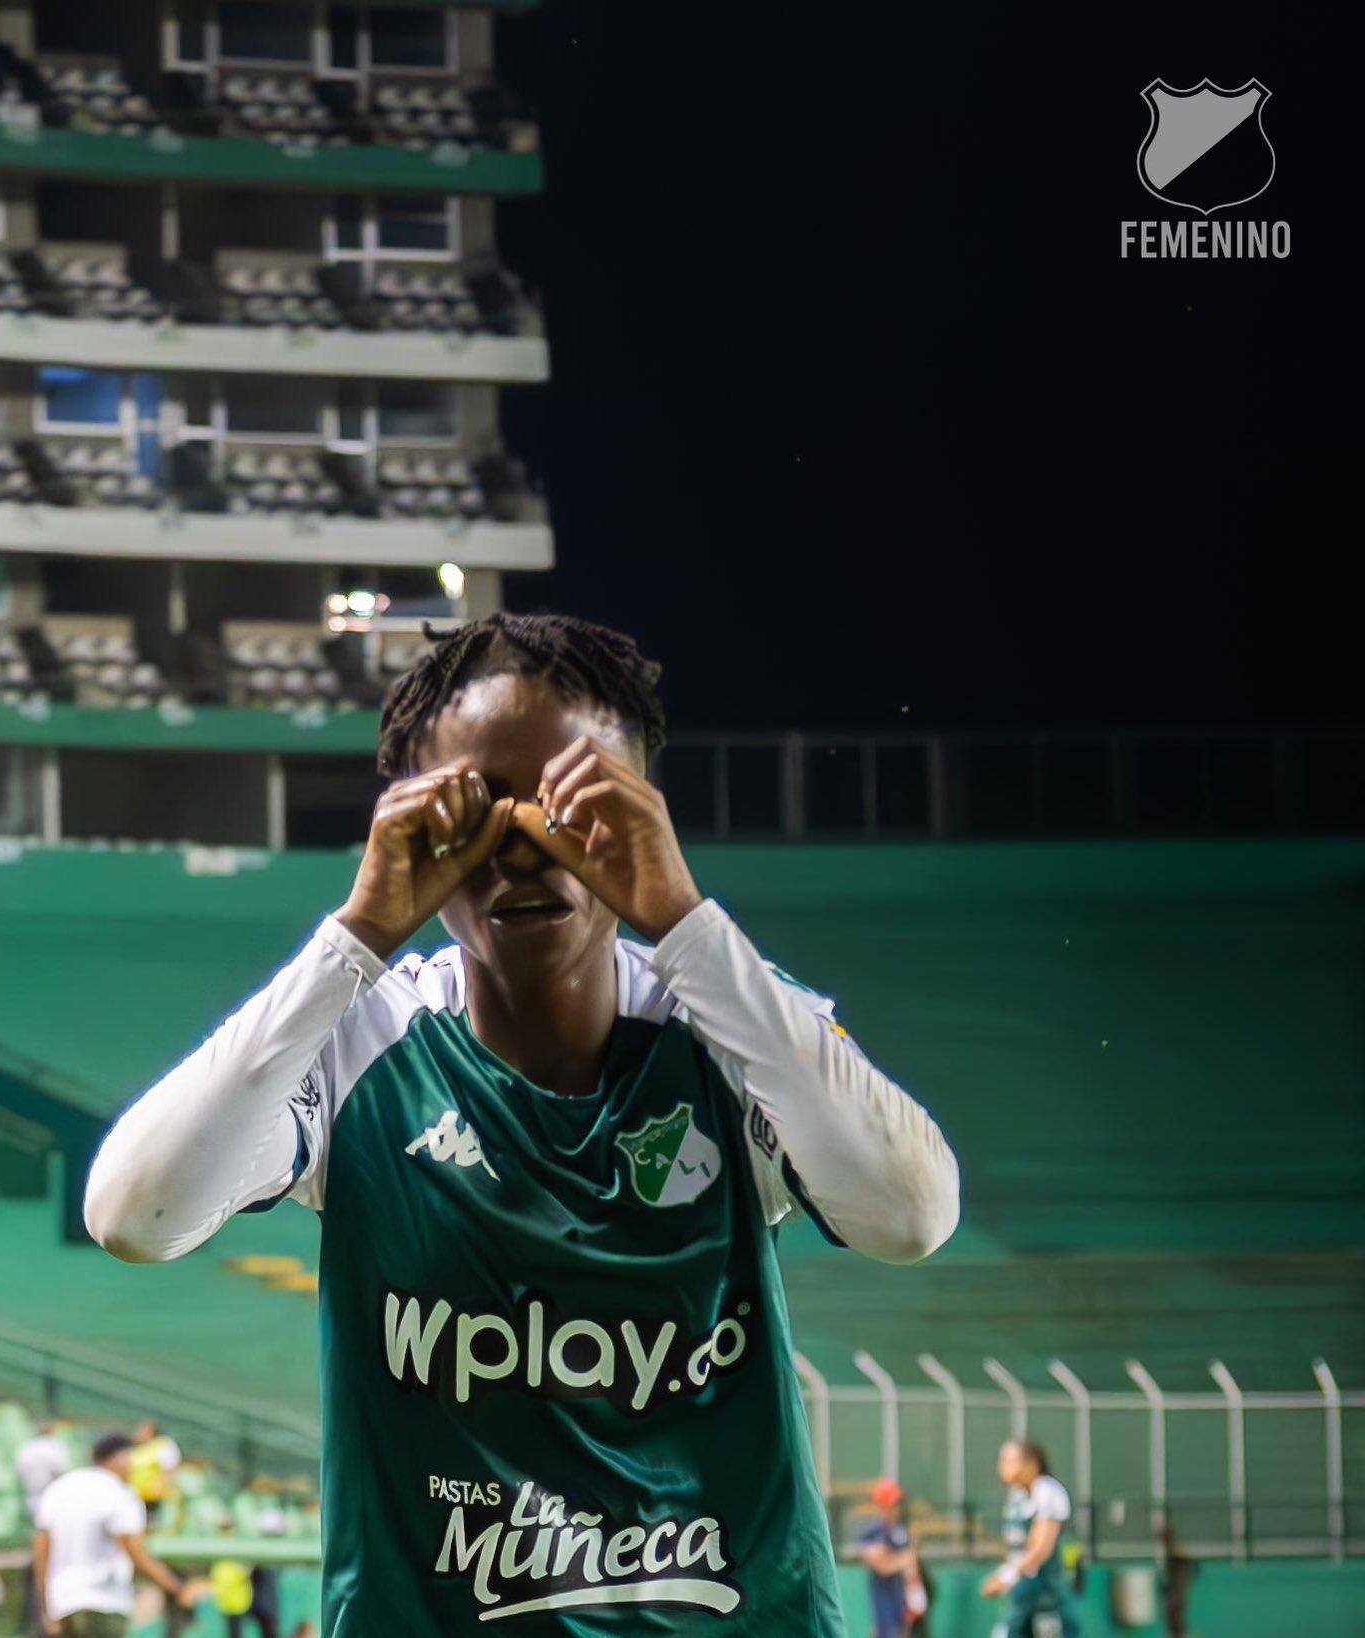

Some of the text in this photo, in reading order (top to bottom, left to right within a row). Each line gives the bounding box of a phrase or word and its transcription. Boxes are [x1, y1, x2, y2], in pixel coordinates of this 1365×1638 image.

[384, 1291, 747, 1411] Wplay.co
[428, 1475, 568, 1528] PASTAS La
[434, 1506, 728, 1605] Muñeca
